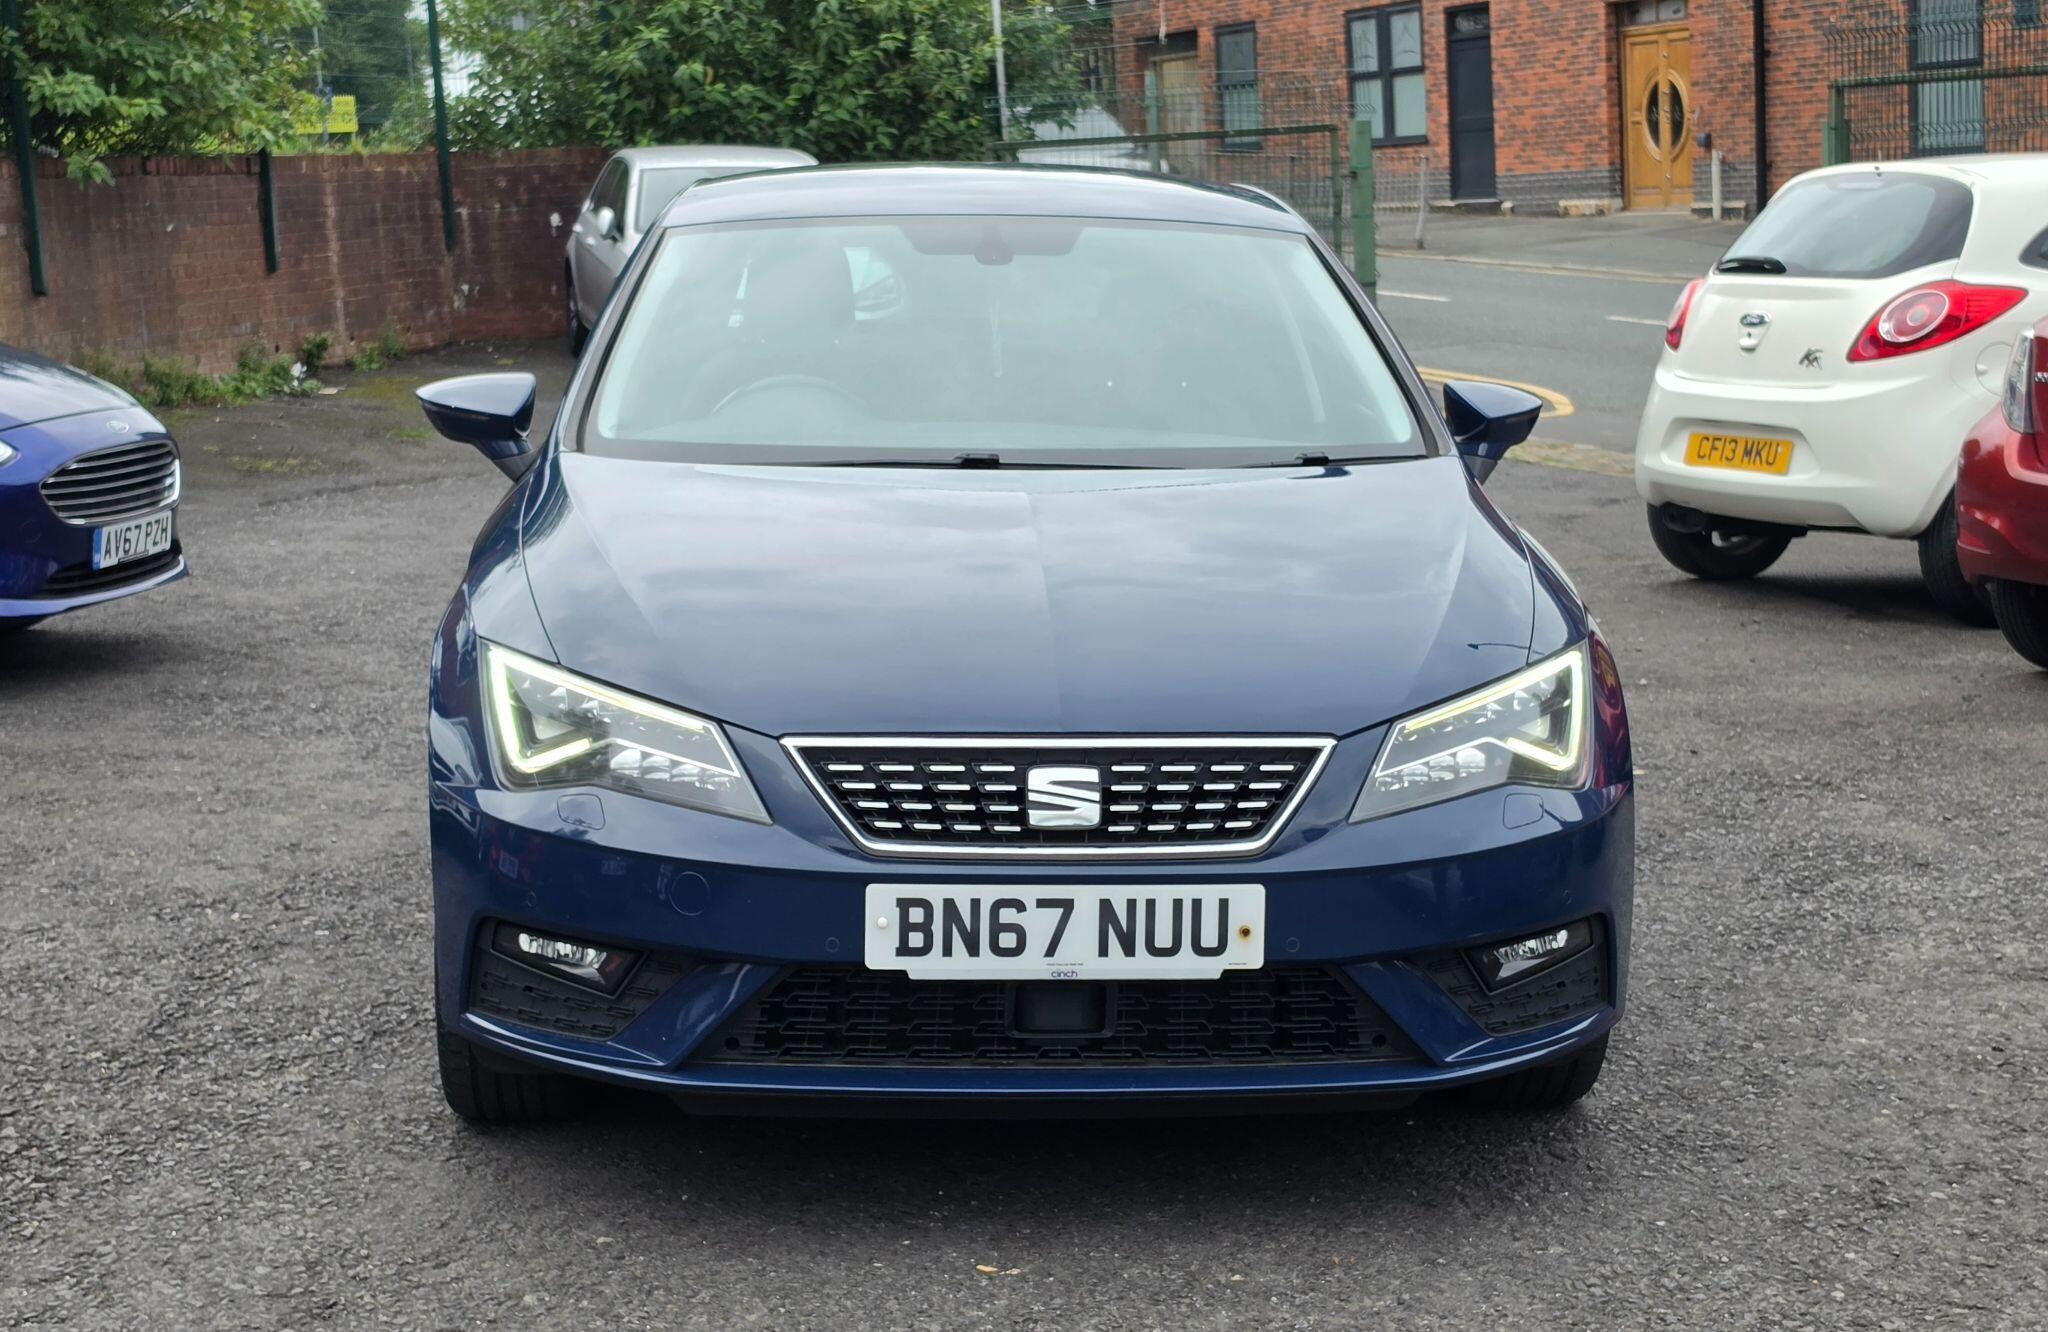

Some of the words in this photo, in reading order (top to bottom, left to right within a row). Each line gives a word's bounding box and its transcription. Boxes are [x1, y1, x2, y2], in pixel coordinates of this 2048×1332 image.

[1697, 436, 1738, 462] CF13
[1740, 438, 1780, 467] MKU
[104, 524, 142, 560] AV67
[144, 516, 169, 552] PZH
[895, 897, 1075, 958] BN67
[1098, 898, 1230, 958] NUU
[1050, 969, 1078, 978] cinch
